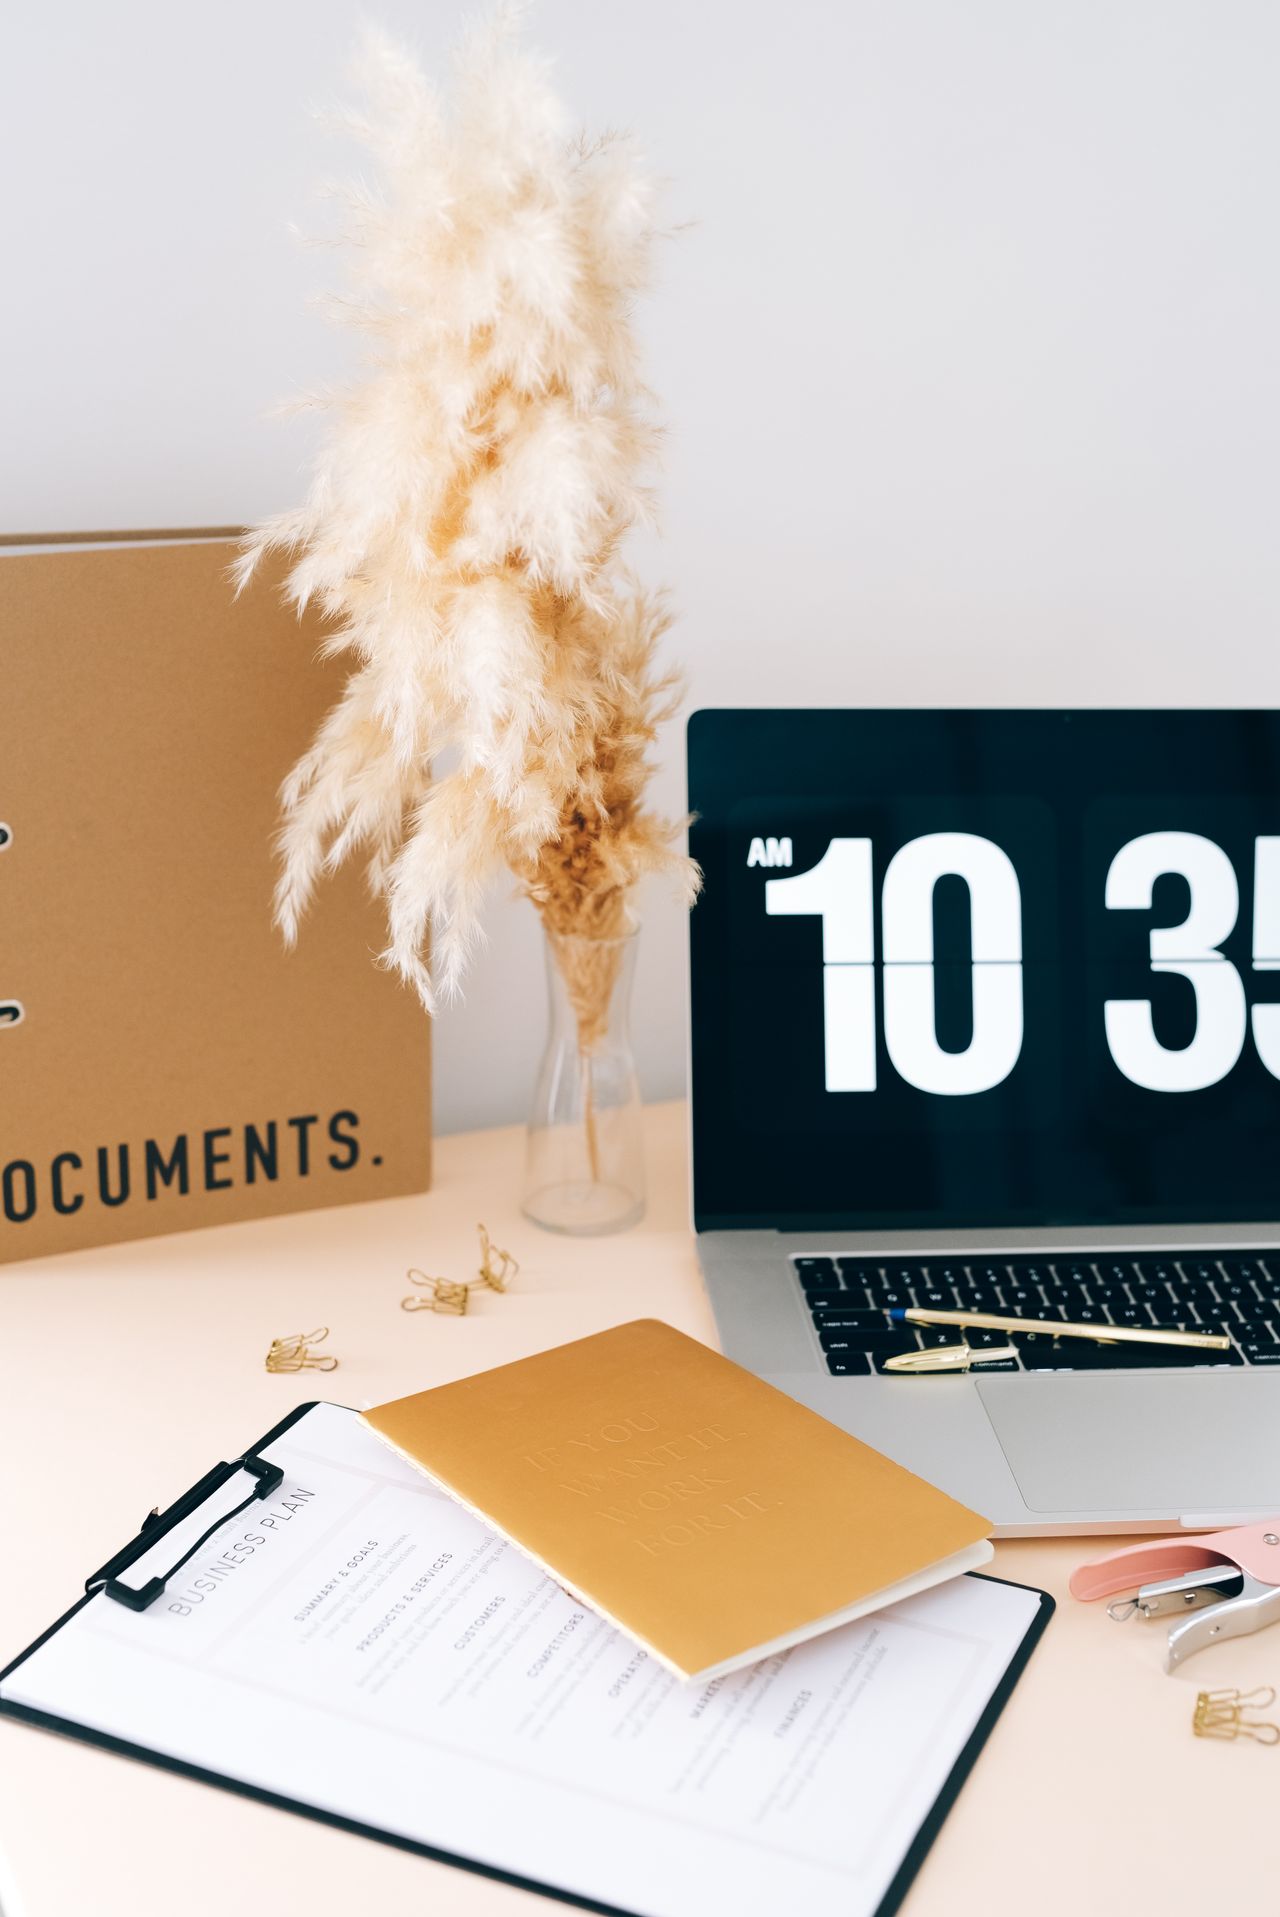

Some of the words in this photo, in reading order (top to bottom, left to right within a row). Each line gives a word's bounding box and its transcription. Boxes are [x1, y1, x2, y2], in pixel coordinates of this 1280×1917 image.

[747, 837, 793, 868] AM
[765, 832, 1024, 1096] 10
[1104, 831, 1280, 1092] 3
[567, 1410, 660, 1453] YOU
[558, 1440, 688, 1497] WANT
[594, 1468, 735, 1525] WORK
[167, 1533, 265, 1617] BUSINESS
[260, 1488, 316, 1530] PLAN
[633, 1514, 731, 1557] FOR
[294, 1578, 340, 1622] SUMMARY
[338, 1569, 350, 1577] &
[347, 1540, 379, 1568] GOALS
[355, 1603, 406, 1653] PRODUCTS
[410, 1552, 453, 1592] SERVICES
[454, 1595, 506, 1650] CUSTOMERS
[526, 1613, 584, 1679] COMPETITORS
